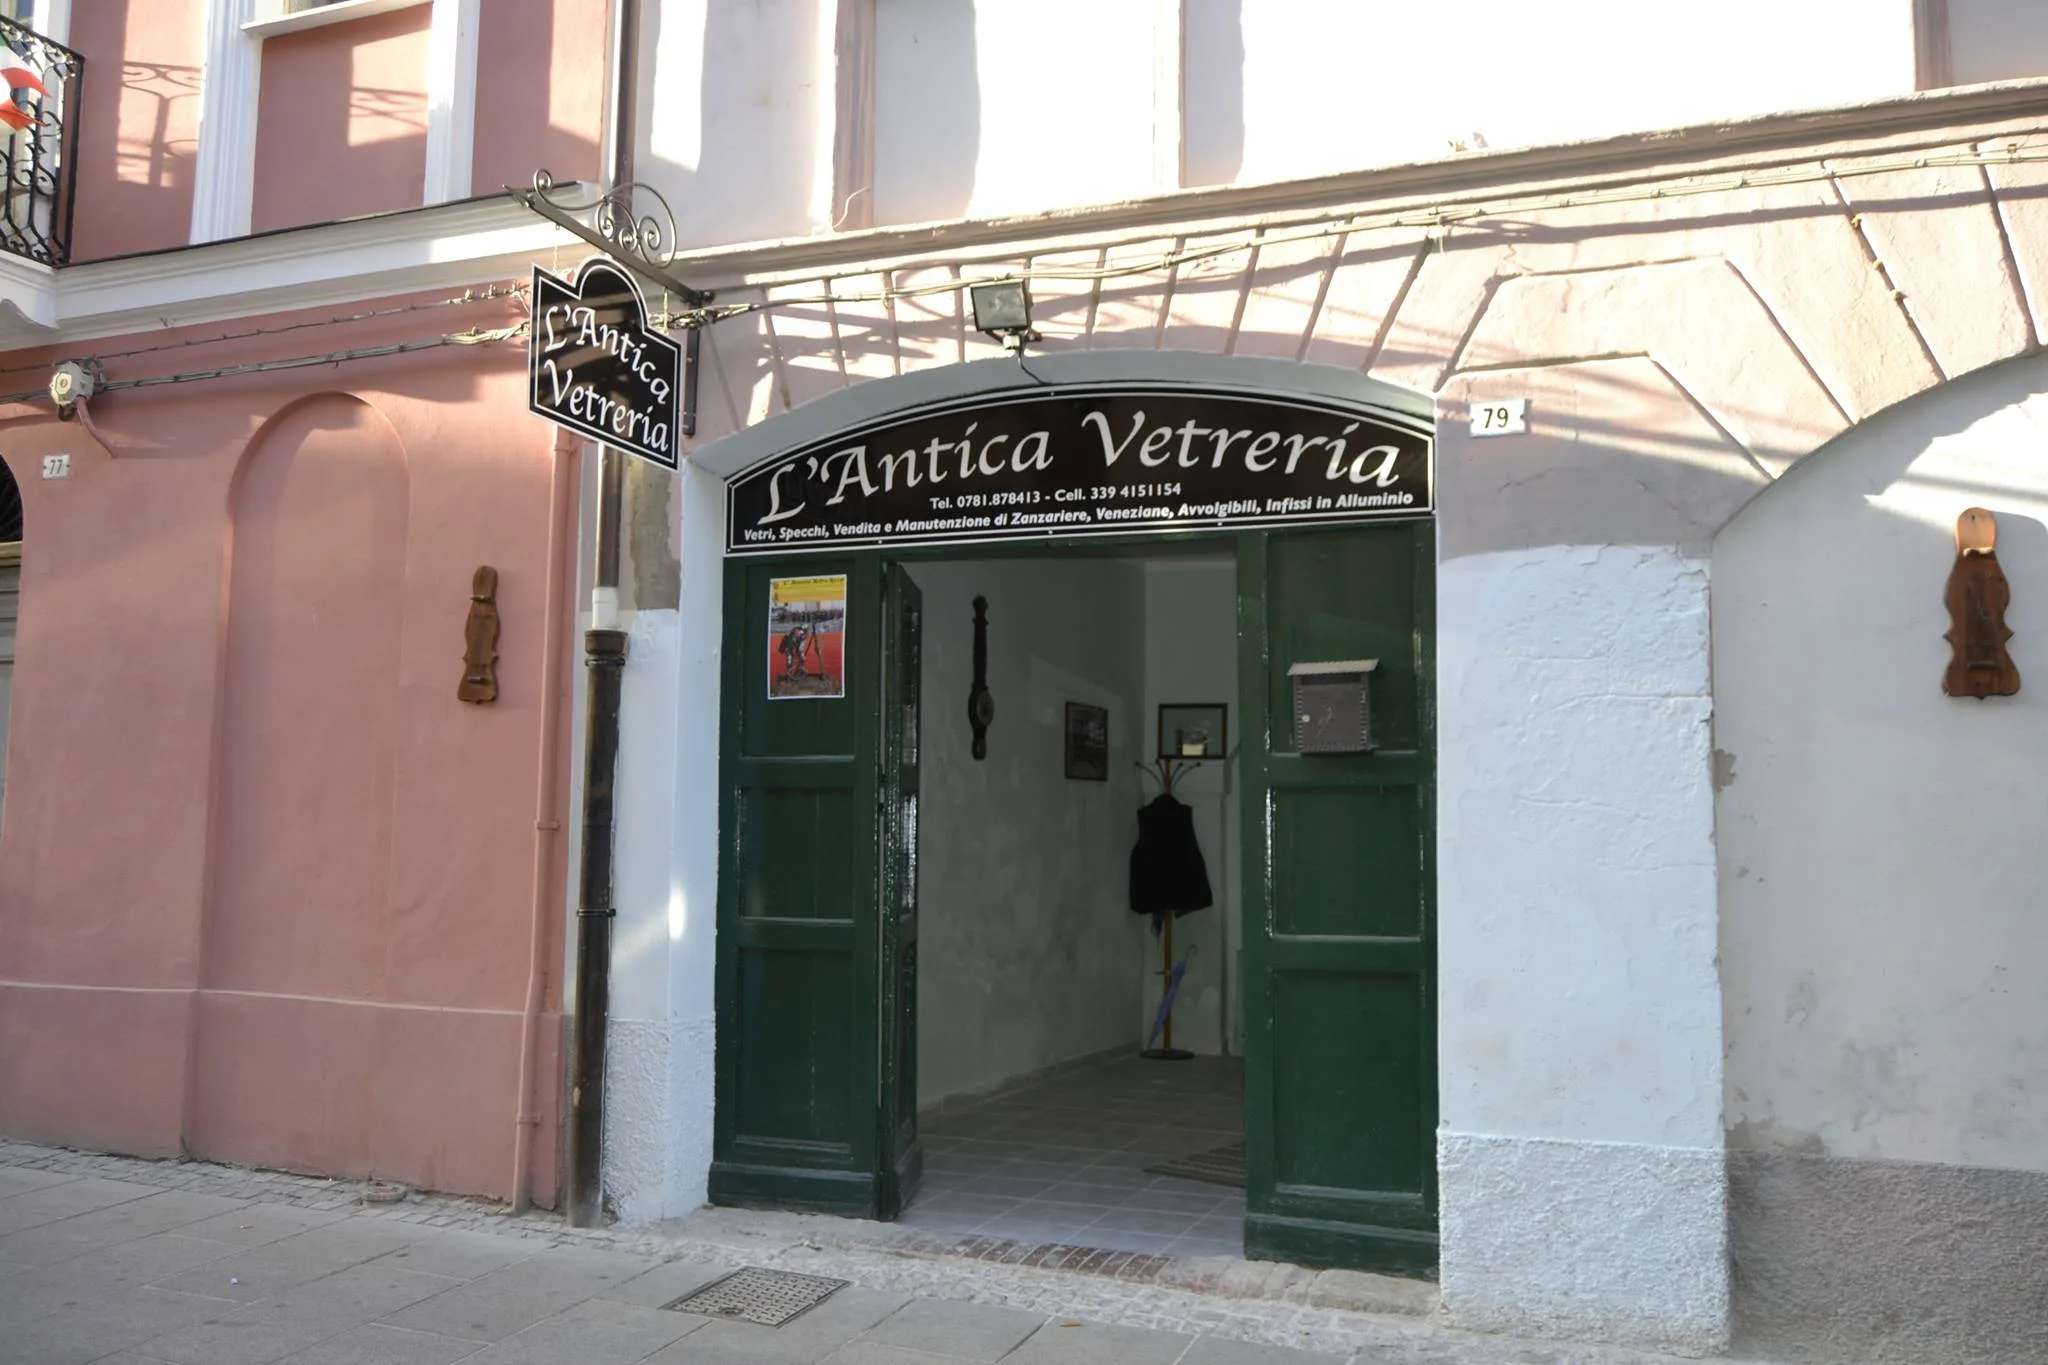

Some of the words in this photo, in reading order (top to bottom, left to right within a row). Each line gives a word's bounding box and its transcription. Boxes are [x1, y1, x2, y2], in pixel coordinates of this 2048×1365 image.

[544, 304, 670, 405] L'Antica
[544, 359, 669, 452] Vetreria
[1483, 407, 1509, 429] 79
[49, 458, 63, 475] 77
[756, 421, 1054, 525] L'Antica
[1081, 410, 1400, 488] Vetreria
[744, 528, 776, 541] Vetri,
[779, 524, 830, 541] Specchi,
[833, 522, 881, 536] Vendita
[884, 523, 892, 532] e
[895, 515, 991, 532] Manutenzione
[993, 512, 1008, 526] di
[1010, 509, 1092, 525] Zanzariere,
[1095, 505, 1174, 521] Veneziane,
[1177, 499, 1262, 518] Avvolgibili,
[1265, 495, 1312, 514] Infissi
[1316, 495, 1332, 509] in
[1335, 491, 1414, 508] Alluminio
[930, 497, 953, 510] Tel.
[957, 491, 1041, 508] 0781.878413
[1054, 488, 1086, 502] Cell.
[1090, 486, 1117, 500] 339
[1120, 482, 1182, 498] 4151154
